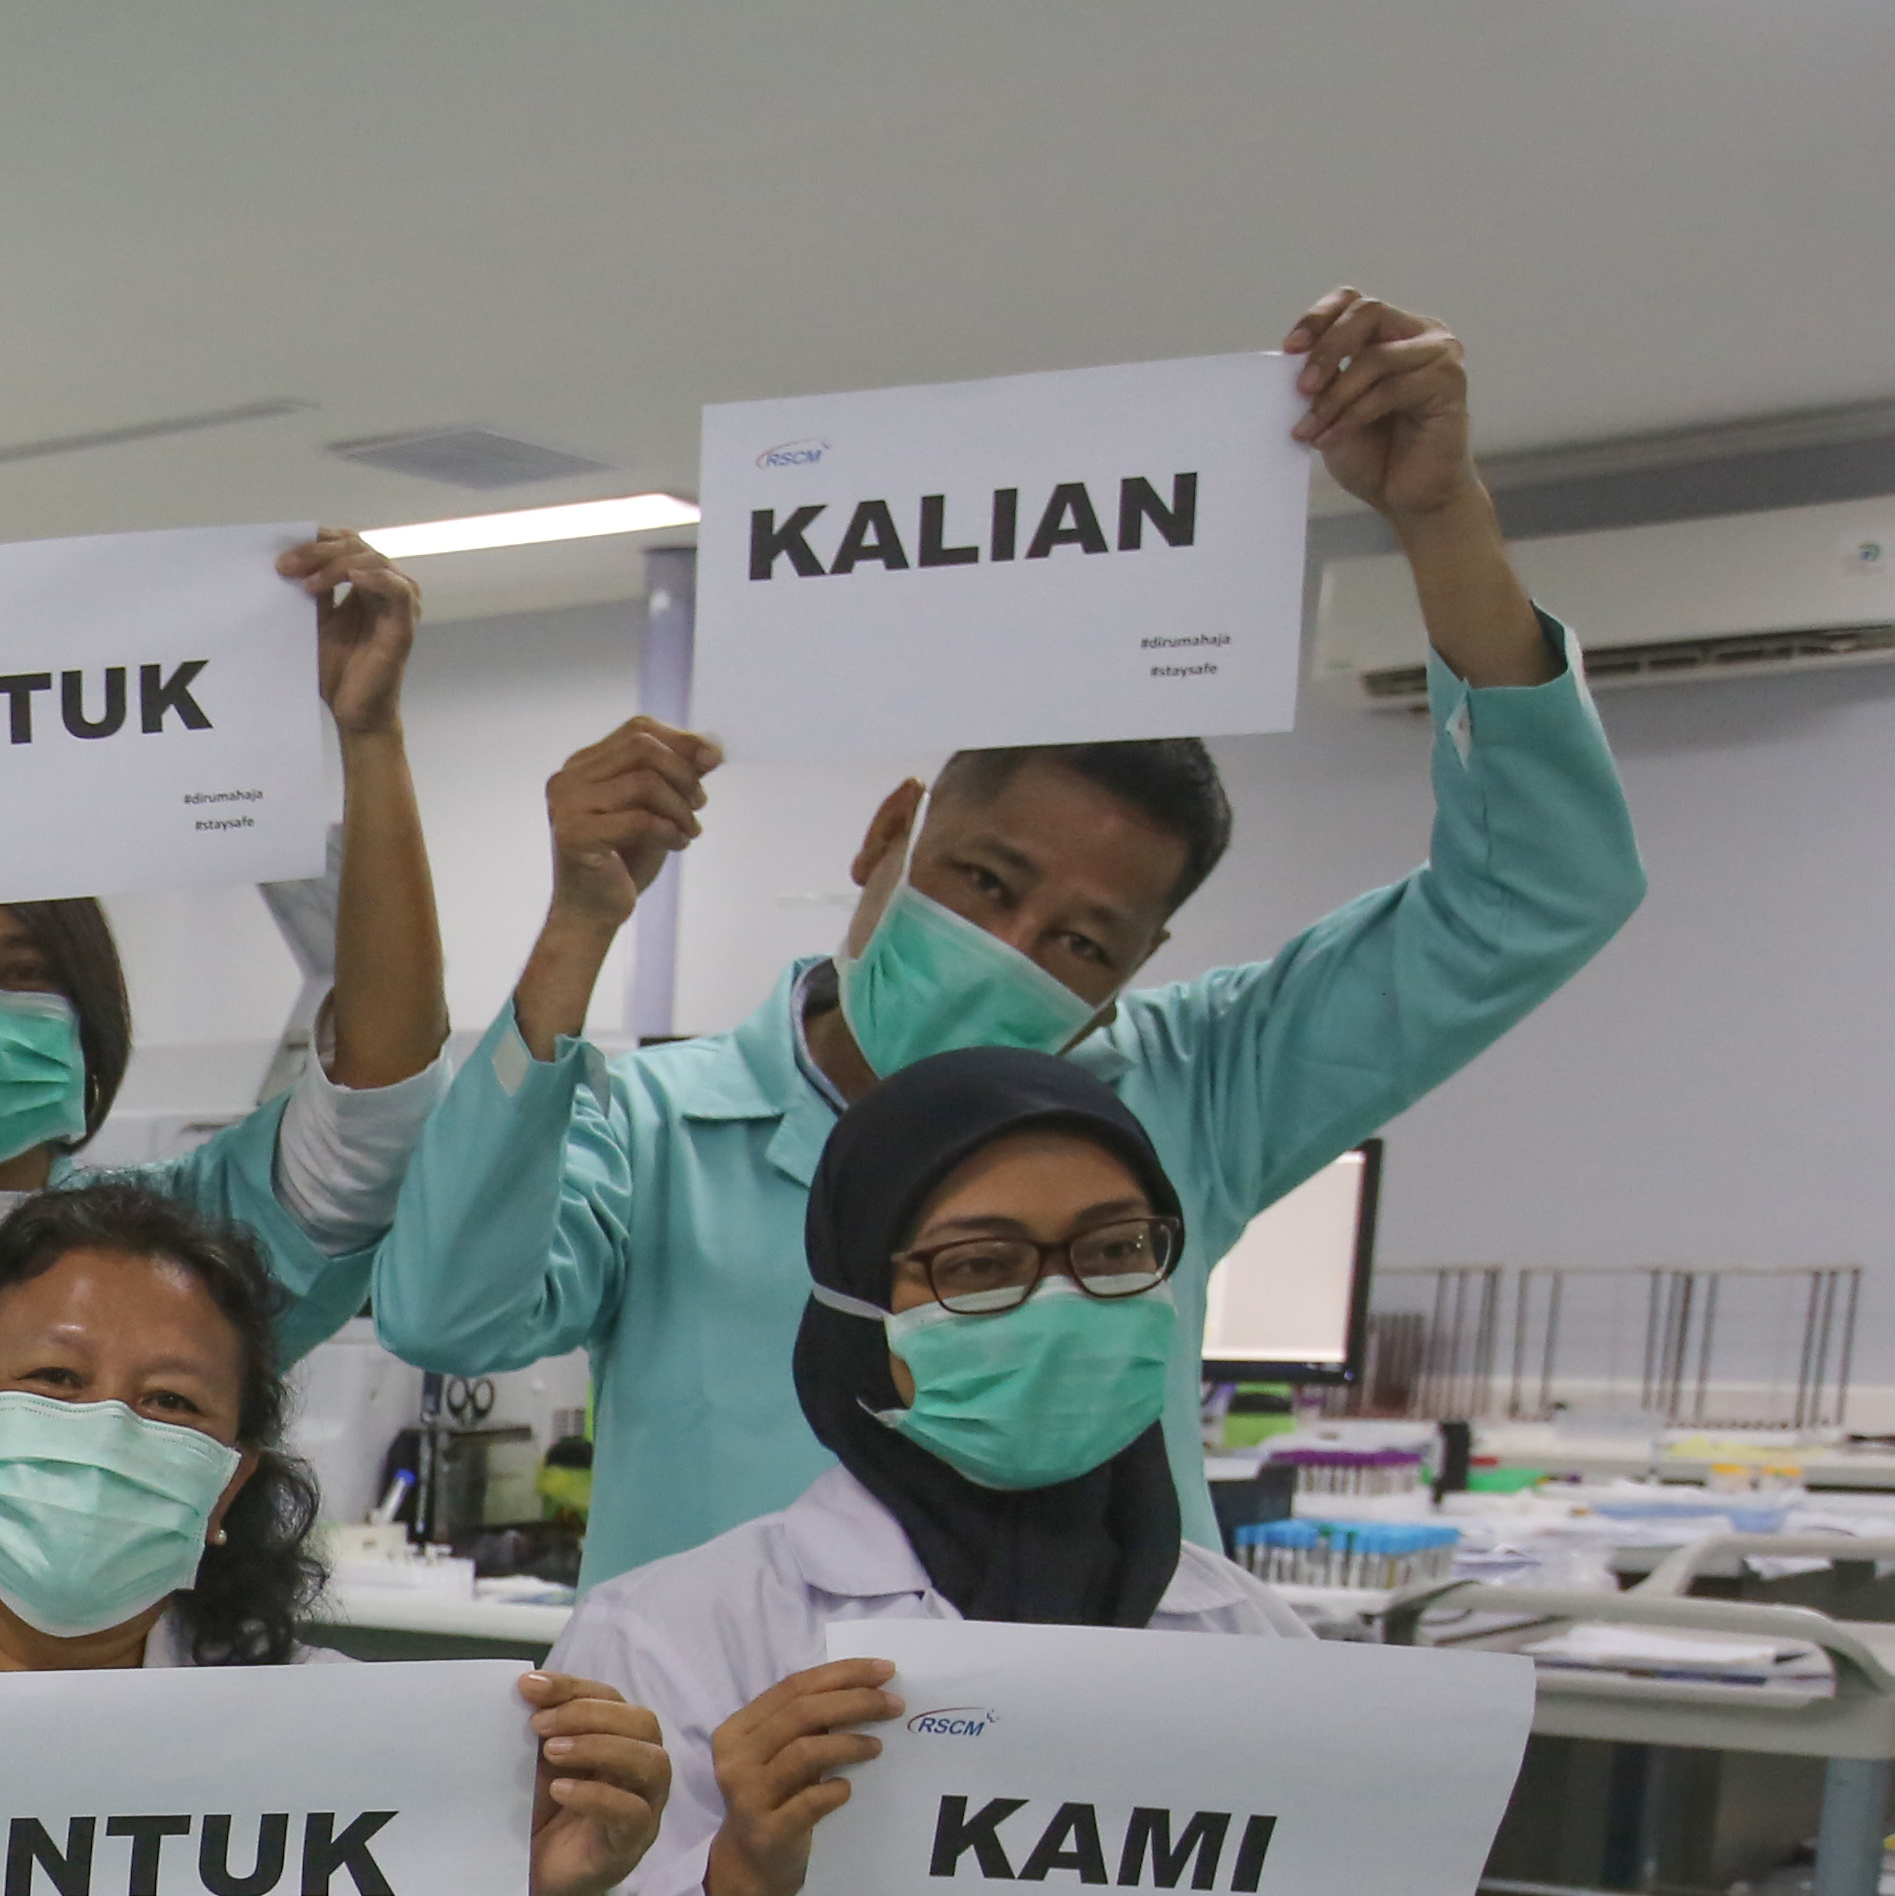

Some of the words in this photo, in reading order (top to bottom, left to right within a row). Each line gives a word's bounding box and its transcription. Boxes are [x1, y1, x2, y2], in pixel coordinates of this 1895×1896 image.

[766, 449, 822, 468] RSCM
[749, 471, 1197, 581] KALIAN
[1141, 634, 1231, 649] #dirumahaja
[1150, 664, 1217, 678] #staysafe
[184, 790, 263, 805] #dirumahaja
[195, 817, 254, 832] #staysafe
[917, 1716, 984, 1736] RSCM
[929, 1795, 1277, 1893] KAMI
